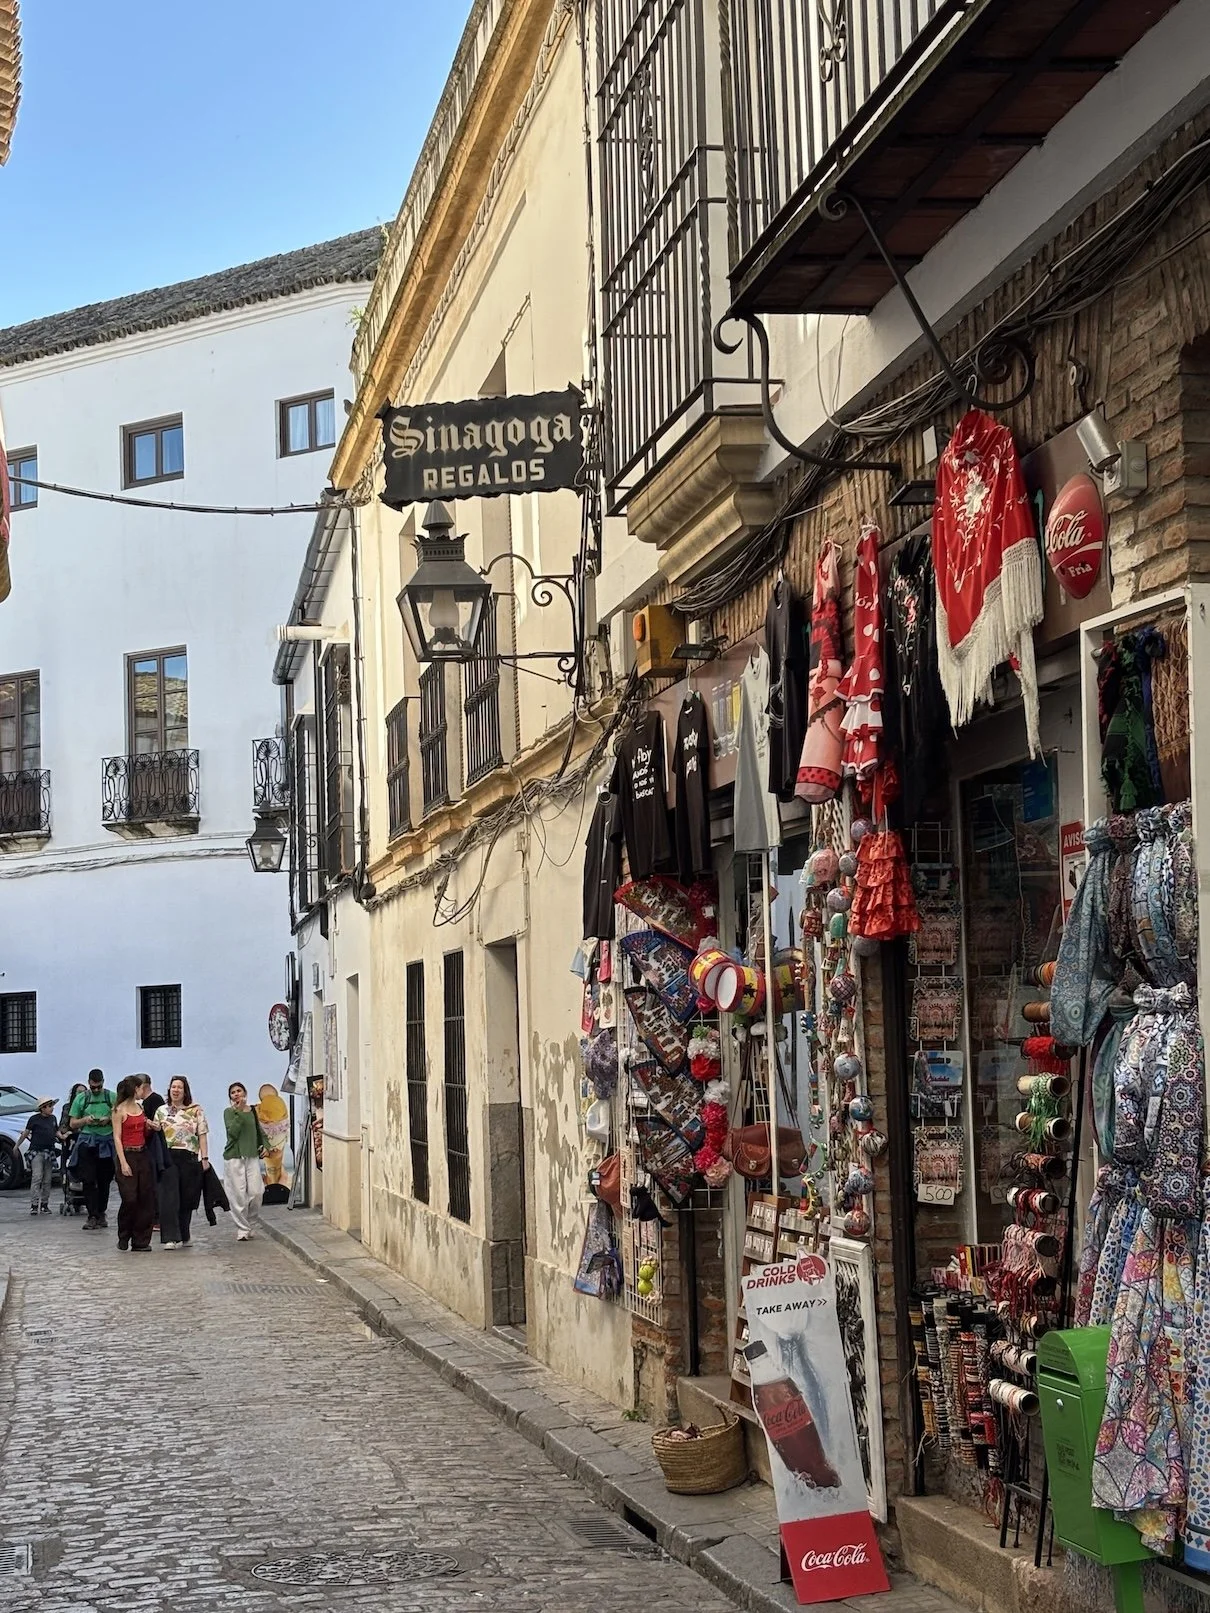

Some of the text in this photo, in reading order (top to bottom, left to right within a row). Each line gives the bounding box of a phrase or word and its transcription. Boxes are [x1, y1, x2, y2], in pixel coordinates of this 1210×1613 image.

[389, 412, 575, 459] Sinagoga
[422, 458, 545, 491] REGALOS
[746, 1273, 796, 1290] DRINKS
[762, 1264, 796, 1278] COLD
[756, 1299, 816, 1316] TAKE AWAY
[801, 1542, 868, 1572] Coca-Cola
